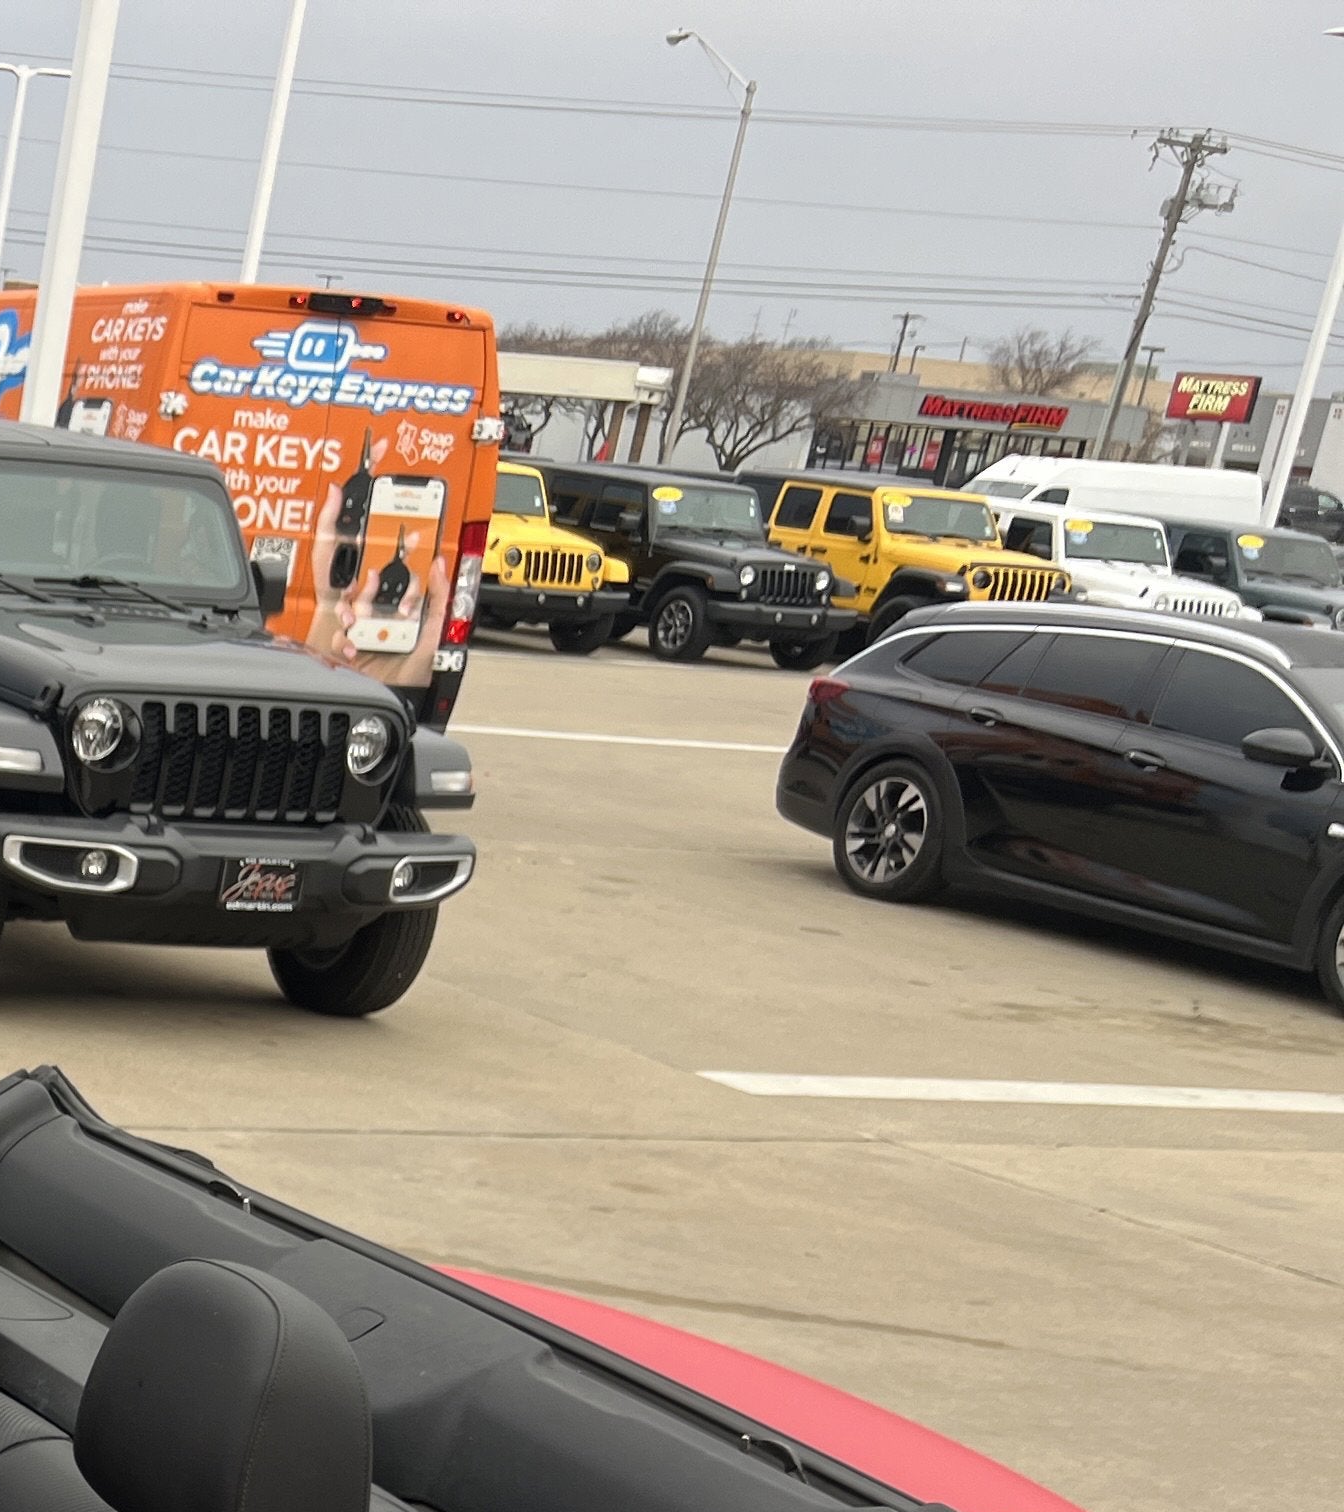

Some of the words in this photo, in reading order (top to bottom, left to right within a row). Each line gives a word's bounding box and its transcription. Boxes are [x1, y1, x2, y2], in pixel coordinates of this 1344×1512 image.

[91, 317, 125, 343] CAR
[123, 315, 168, 342] KEYS
[190, 362, 251, 393] Car
[251, 364, 337, 406] Keys
[335, 374, 473, 412] Express
[1177, 375, 1249, 397] MATTRESS
[919, 394, 1015, 424] MATTRESS
[1012, 402, 1069, 428] FIRM
[1188, 393, 1232, 412] FIRM
[233, 407, 290, 431] make
[173, 427, 248, 464] CAR
[254, 434, 342, 472] KEYS
[418, 428, 454, 447] Snap
[421, 444, 454, 465] Key
[222, 467, 251, 491] ith
[255, 475, 301, 496] your
[232, 495, 316, 531] ONE!
